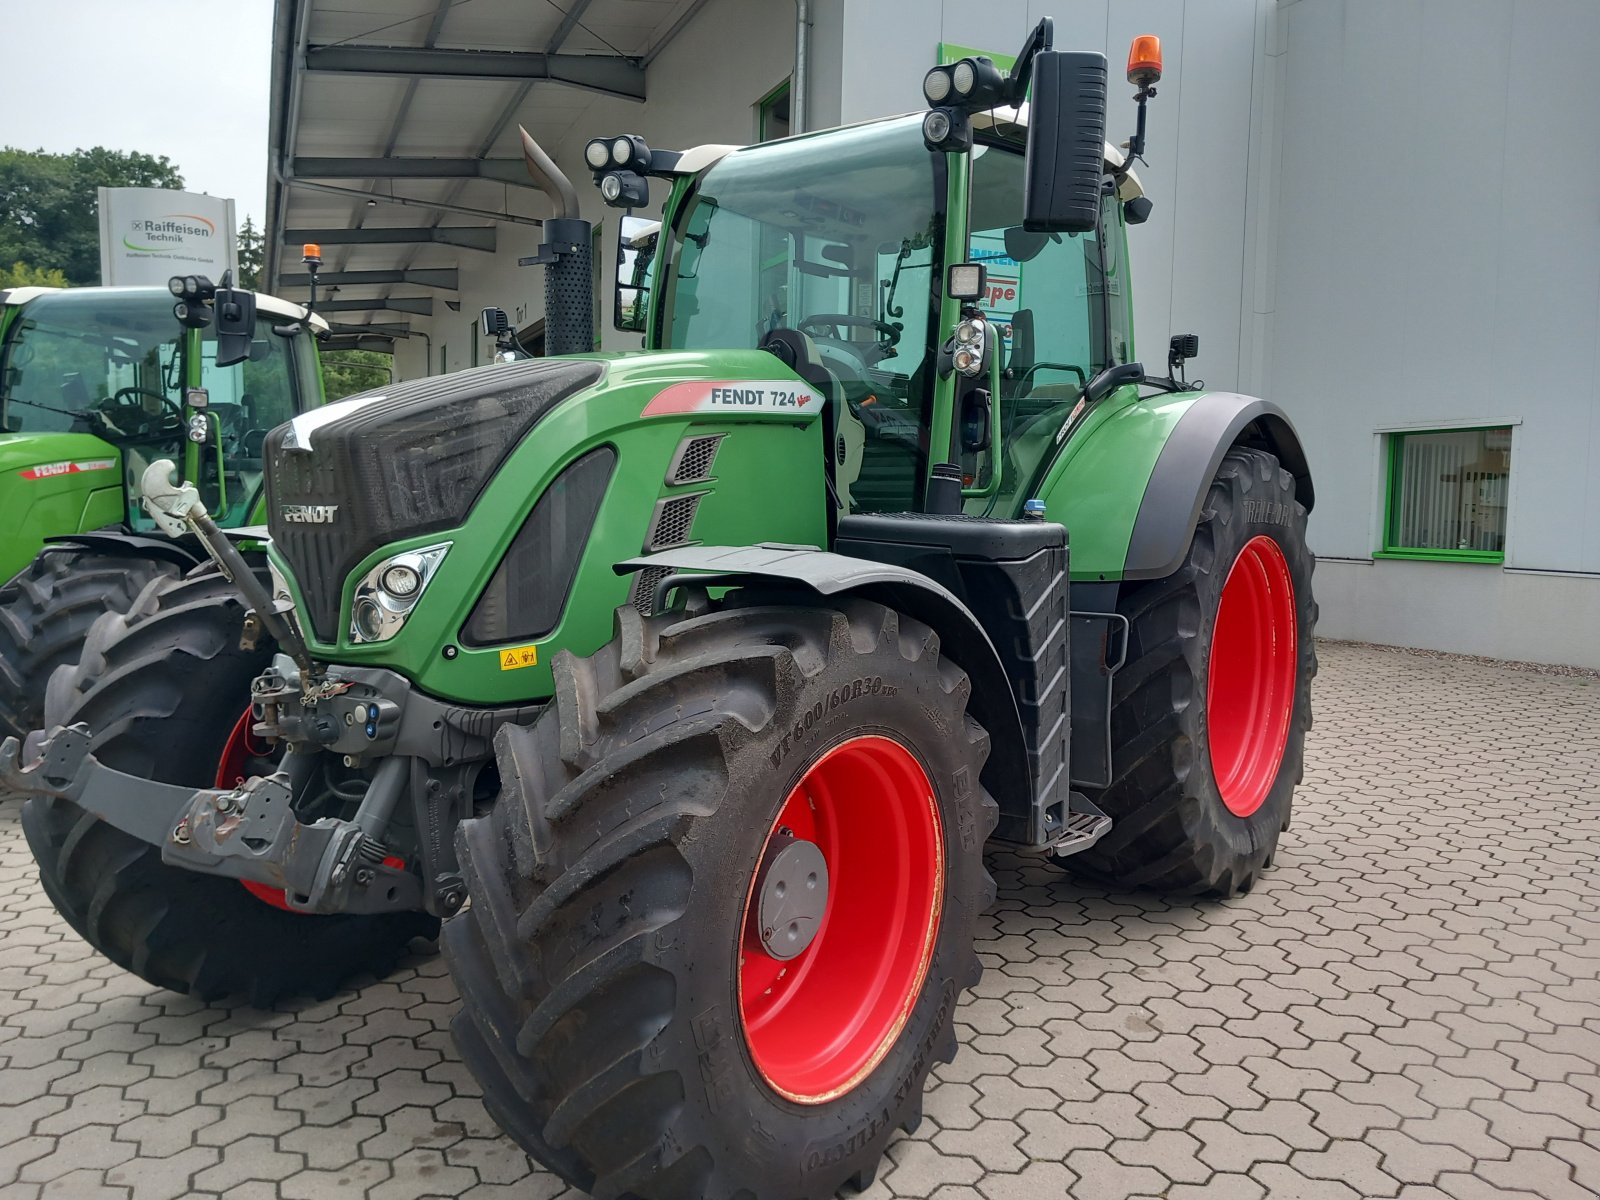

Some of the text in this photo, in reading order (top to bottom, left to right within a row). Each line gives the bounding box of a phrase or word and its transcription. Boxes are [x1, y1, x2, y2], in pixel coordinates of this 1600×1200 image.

[145, 221, 209, 237] Raiffeisen
[146, 232, 183, 243] Technik
[711, 388, 765, 406] FENDT
[770, 391, 796, 406] 724
[33, 461, 72, 478] FENDT
[280, 504, 339, 523] FENDT
